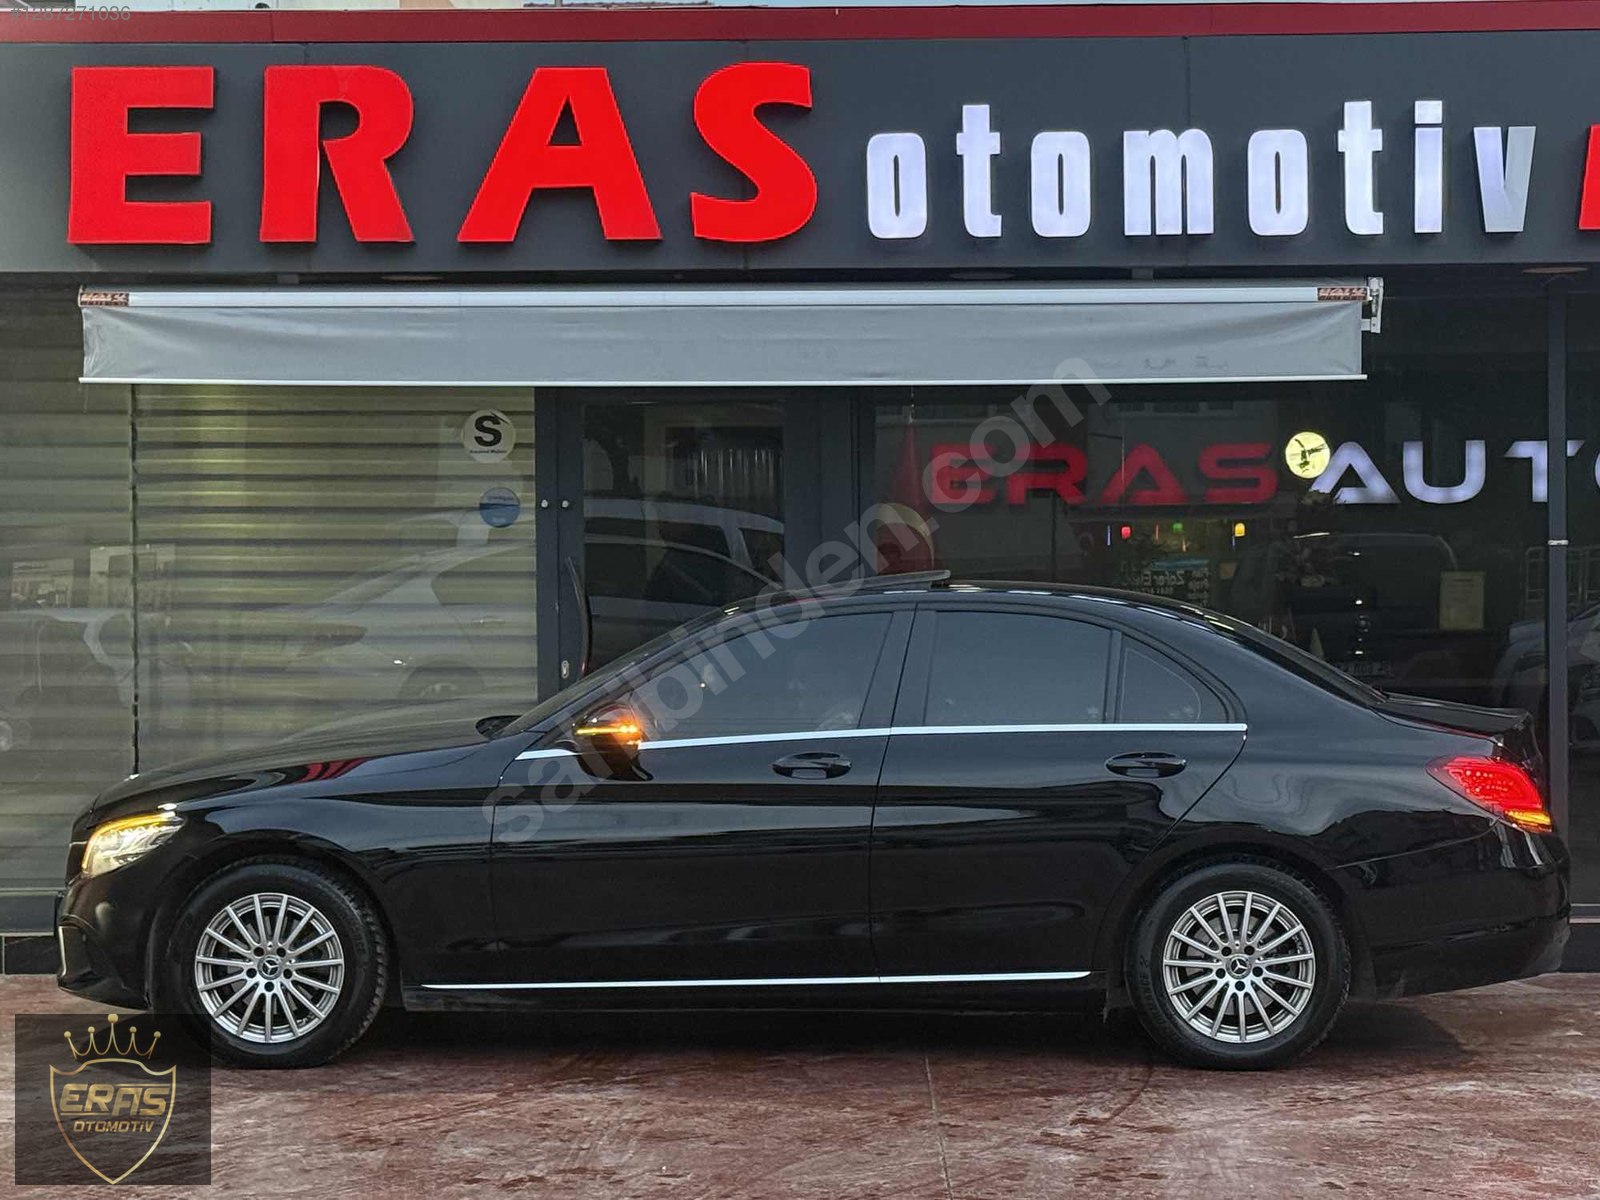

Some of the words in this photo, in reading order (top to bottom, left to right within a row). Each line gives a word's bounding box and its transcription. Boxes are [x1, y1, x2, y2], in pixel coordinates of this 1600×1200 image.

[68, 62, 818, 244] ERAS
[866, 99, 1536, 240] otomotiv
[930, 442, 1278, 506] ERAS
